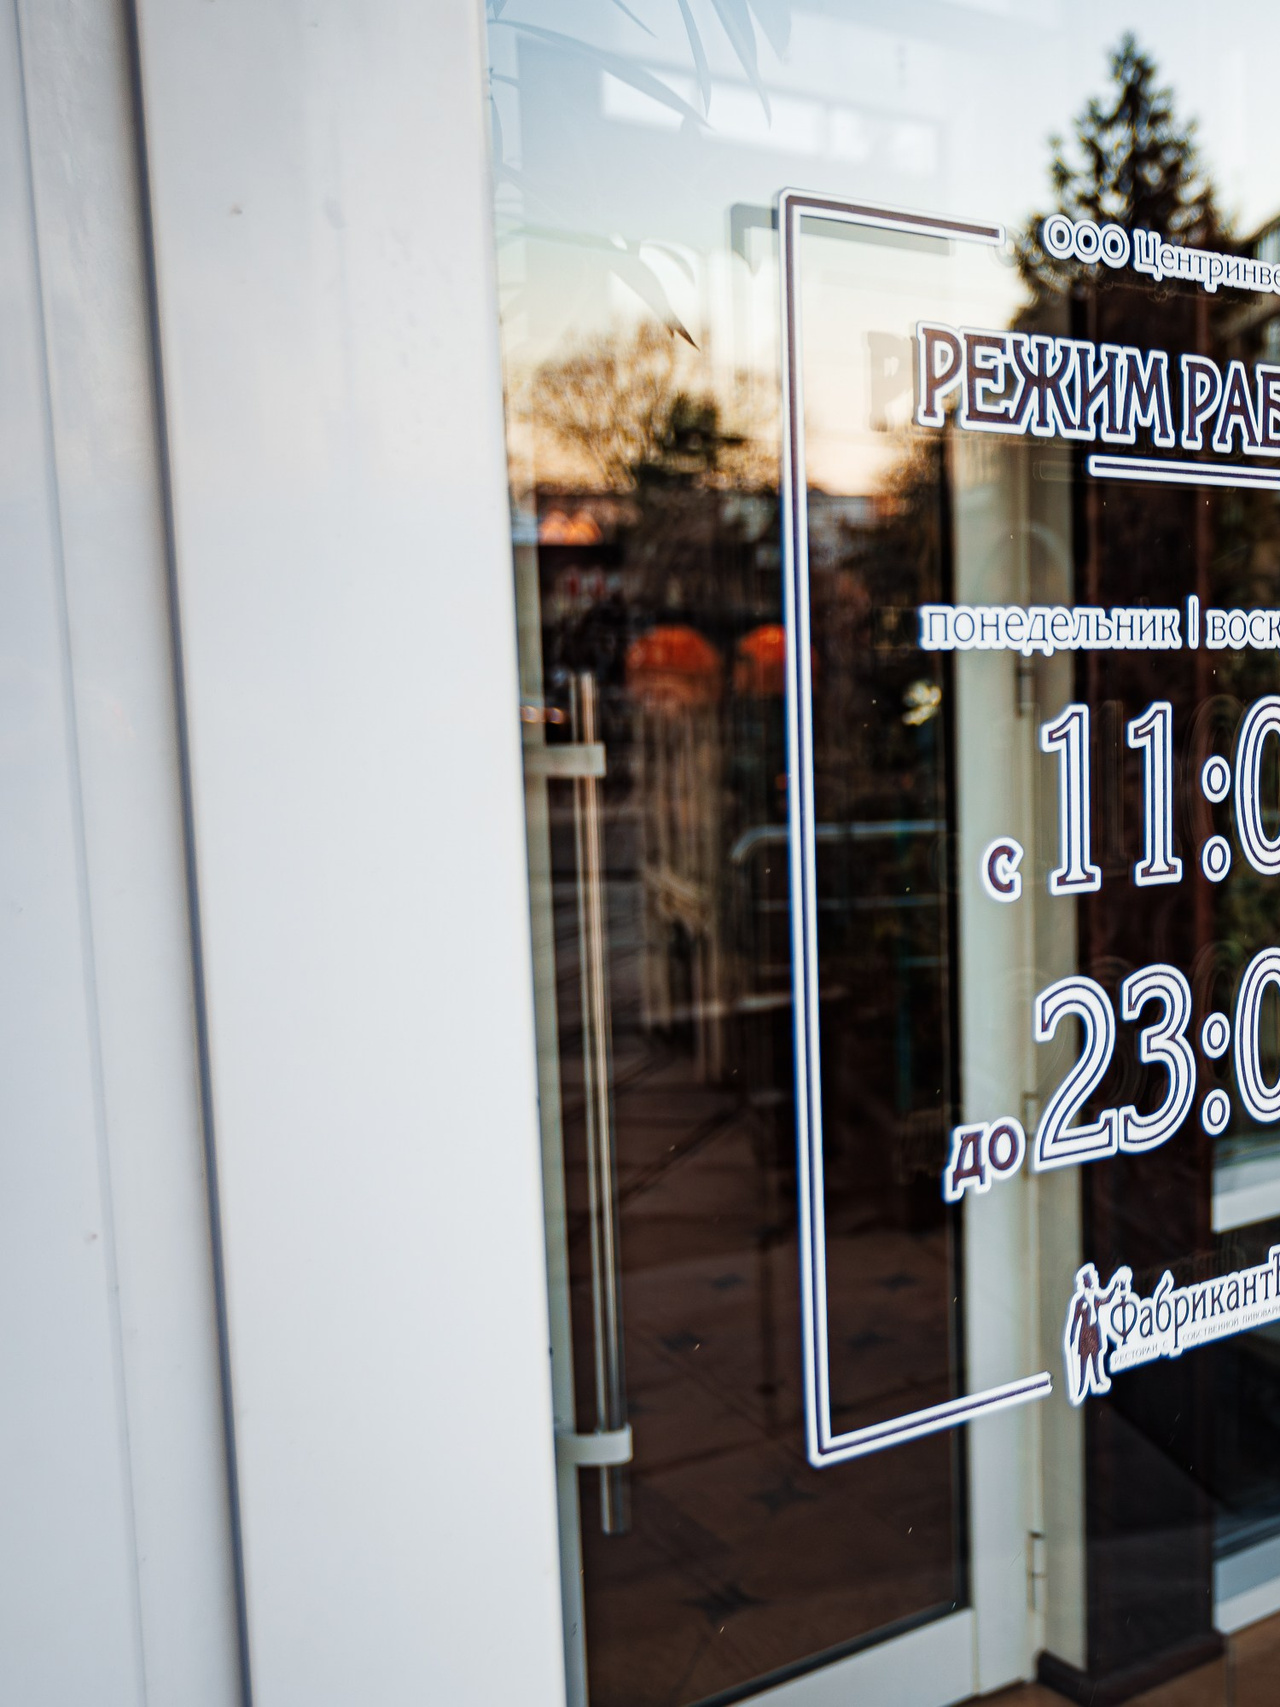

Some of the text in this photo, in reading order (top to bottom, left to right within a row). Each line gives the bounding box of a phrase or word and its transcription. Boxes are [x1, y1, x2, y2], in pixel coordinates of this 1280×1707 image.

[1045, 216, 1128, 266] ООО
[917, 322, 1175, 448] РЕЖИМ
[922, 607, 1181, 655] понедельник
[948, 1118, 1023, 1200] до
